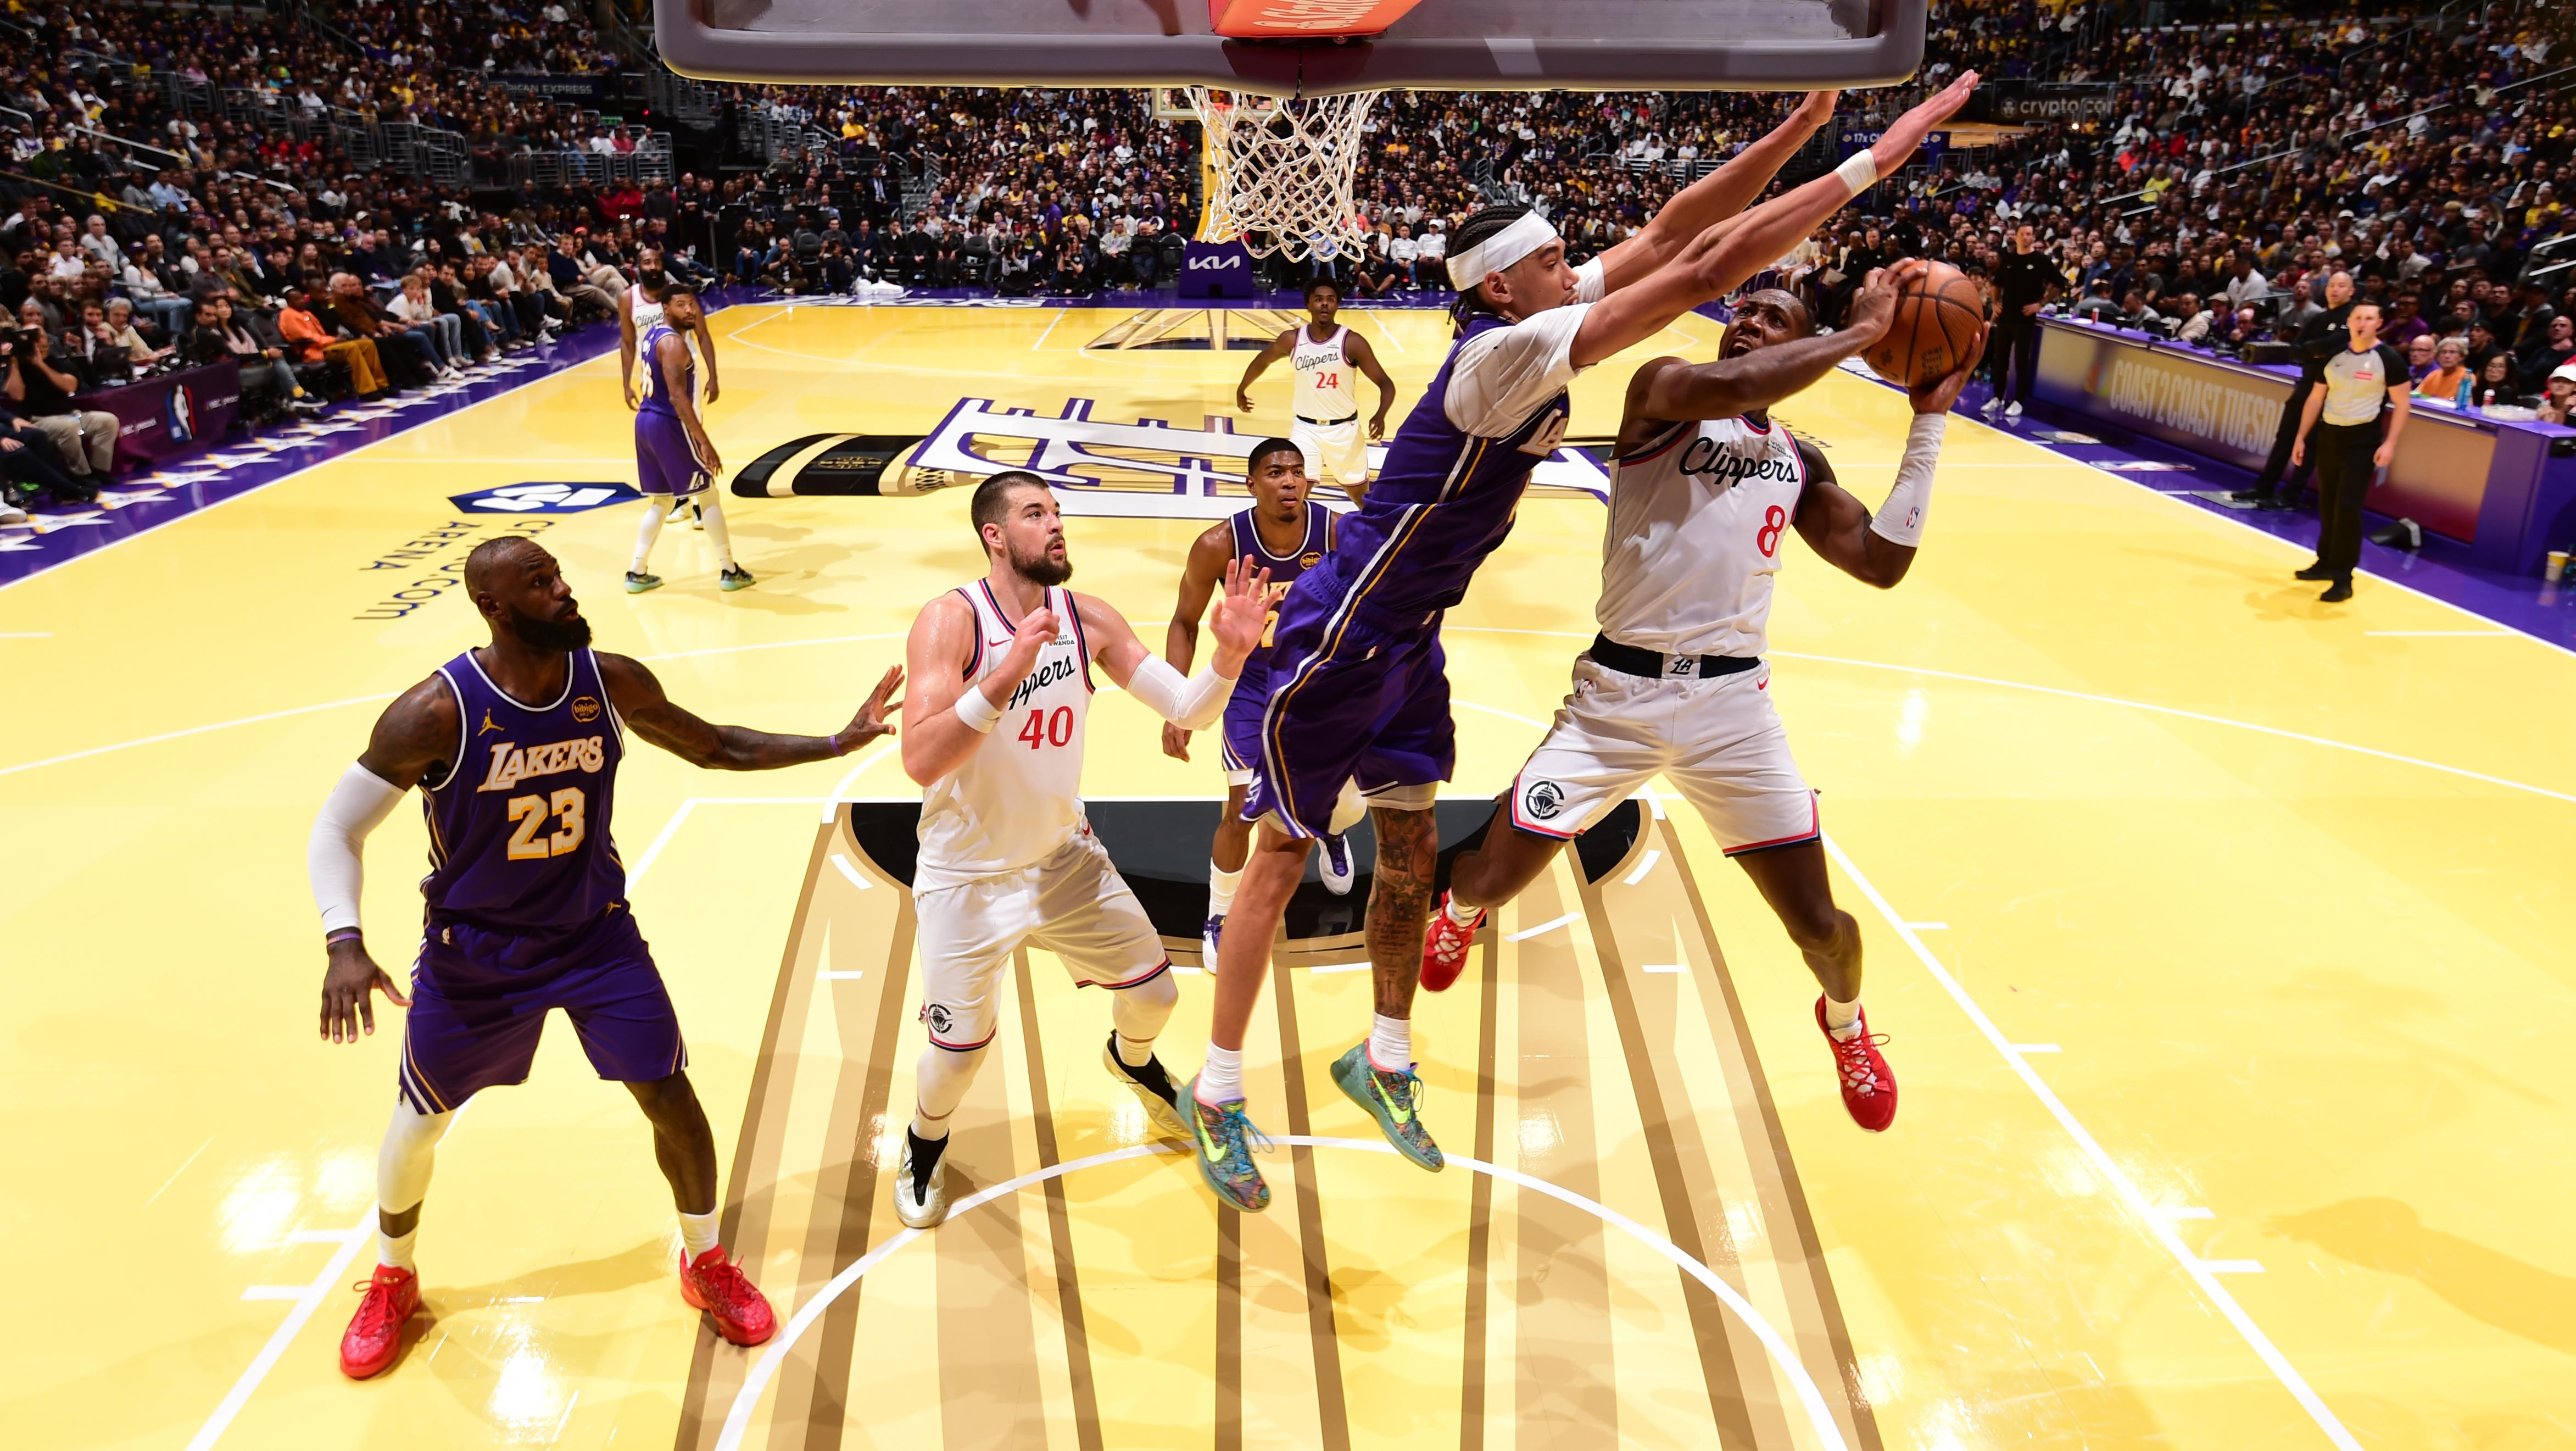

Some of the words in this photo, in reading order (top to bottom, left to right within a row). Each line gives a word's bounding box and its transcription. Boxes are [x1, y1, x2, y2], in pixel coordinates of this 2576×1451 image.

[543, 85, 593, 95] EXPRESS
[1189, 255, 1240, 270] KIA
[635, 312, 665, 329] Clippe
[1295, 352, 1340, 371] Clippers
[1315, 371, 1339, 389] 24
[2110, 359, 2160, 420] COAST
[2155, 371, 2170, 424] 2
[2166, 375, 2223, 440] COAST
[2220, 388, 2287, 456] TUESD
[1679, 437, 1799, 488] Clippers
[358, 521, 484, 571] ARENA
[1757, 505, 1786, 558] 8
[1008, 655, 1076, 711] ppers
[1670, 654, 1694, 675] LA
[574, 703, 599, 714] bibigo
[1018, 705, 1074, 750] 40
[476, 735, 605, 793] LAKERS
[507, 787, 586, 861] 23
